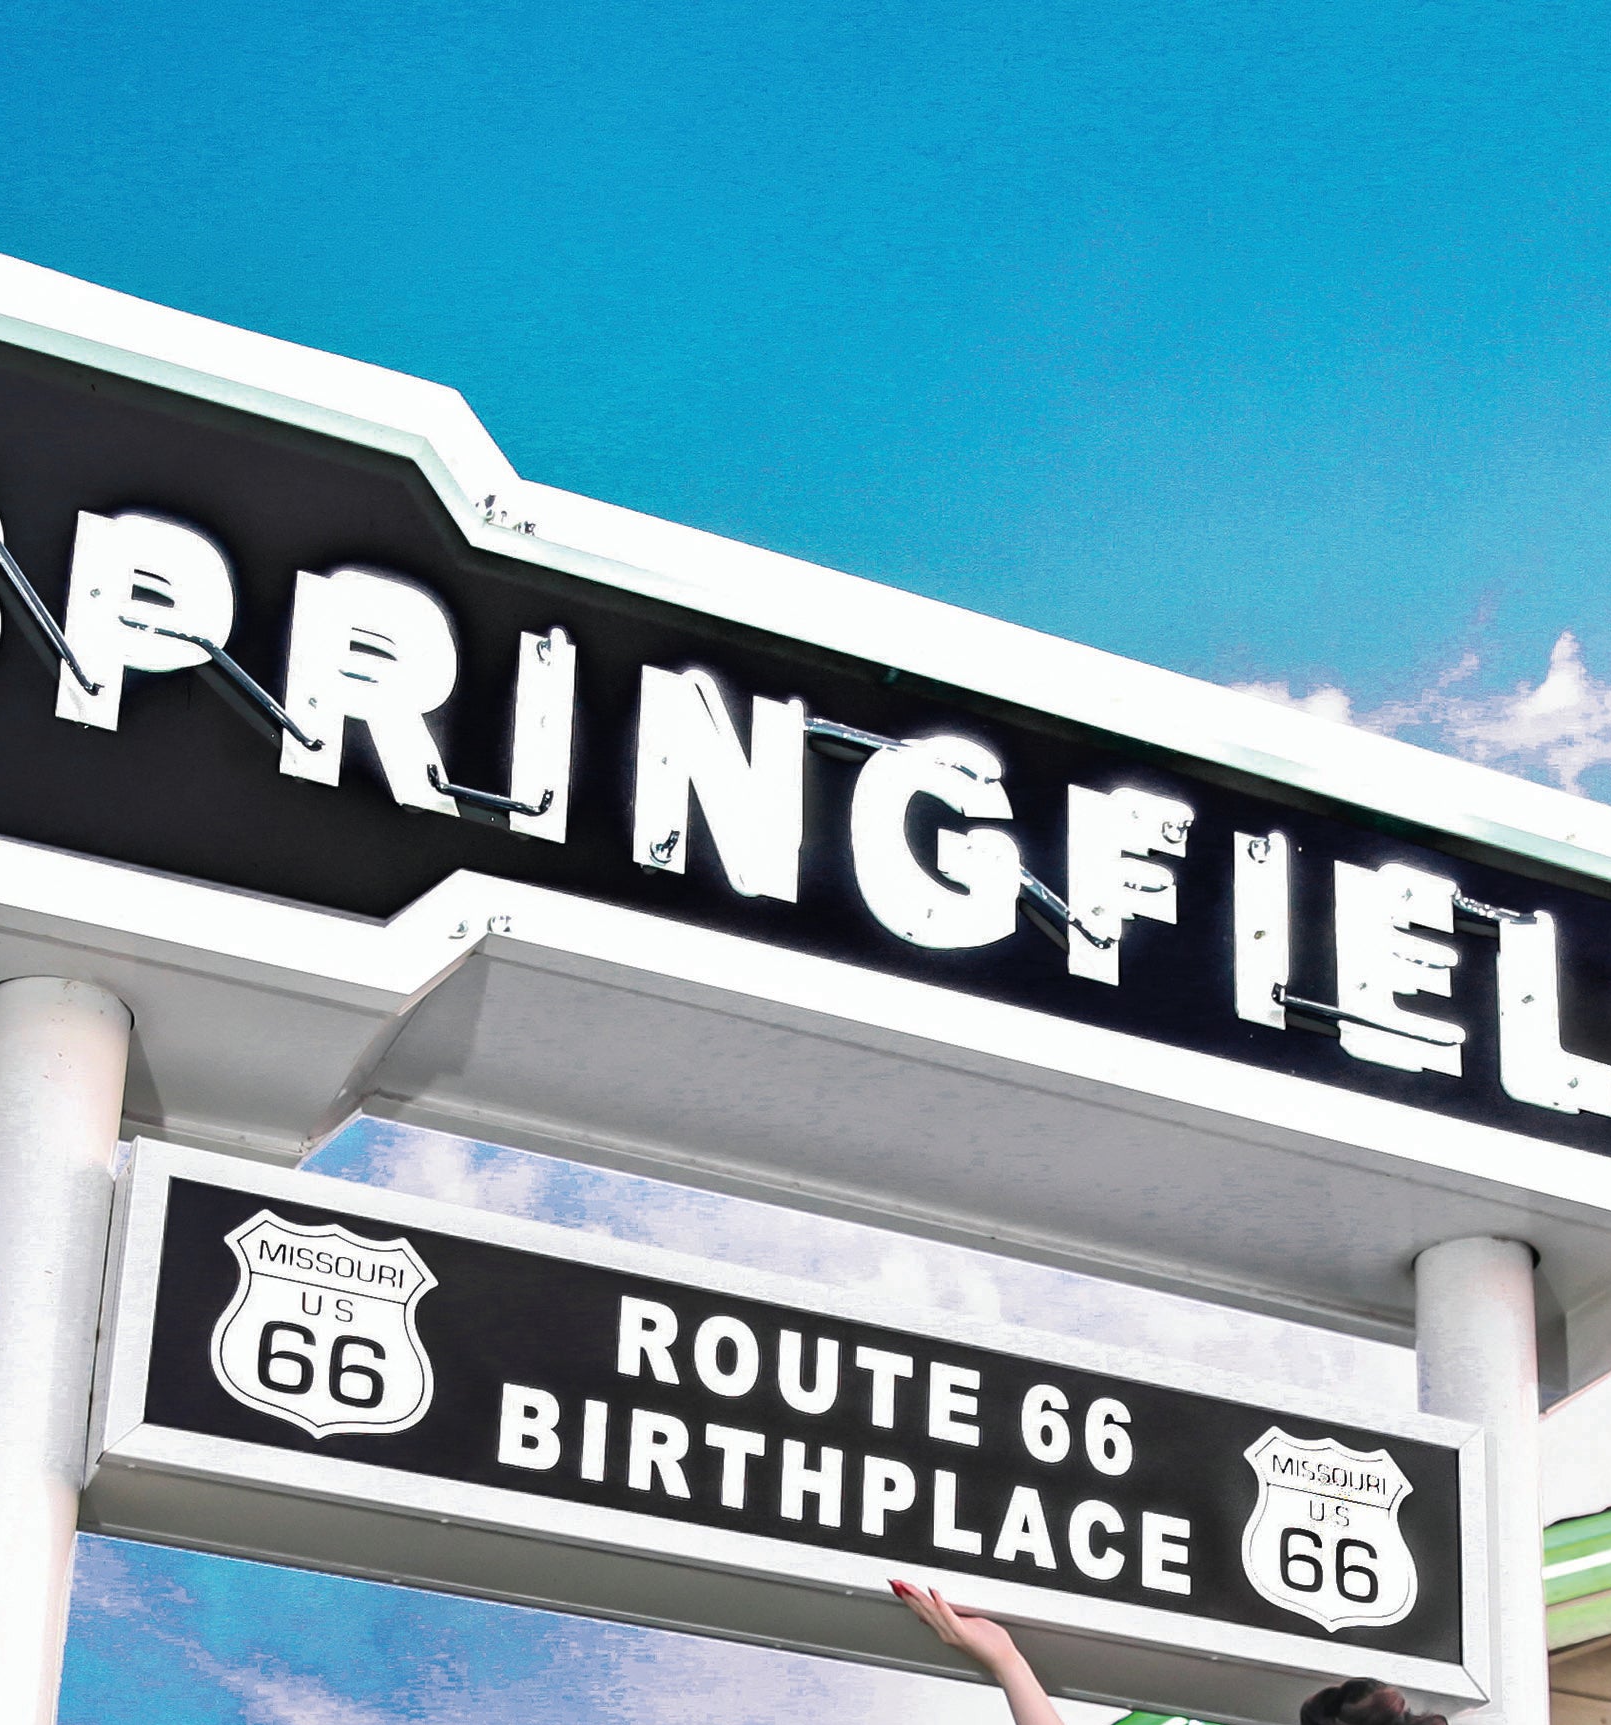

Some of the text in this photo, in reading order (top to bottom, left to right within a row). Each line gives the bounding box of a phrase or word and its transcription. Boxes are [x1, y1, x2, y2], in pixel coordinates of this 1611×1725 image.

[259, 1239, 404, 1289] MISSOURI
[257, 1320, 386, 1409] 66
[617, 1295, 1134, 1477] ROUTE 66
[497, 1382, 1192, 1597] BIRTHPLACE
[1272, 1454, 1386, 1496] MISSOURI
[1279, 1527, 1379, 1604] 66
